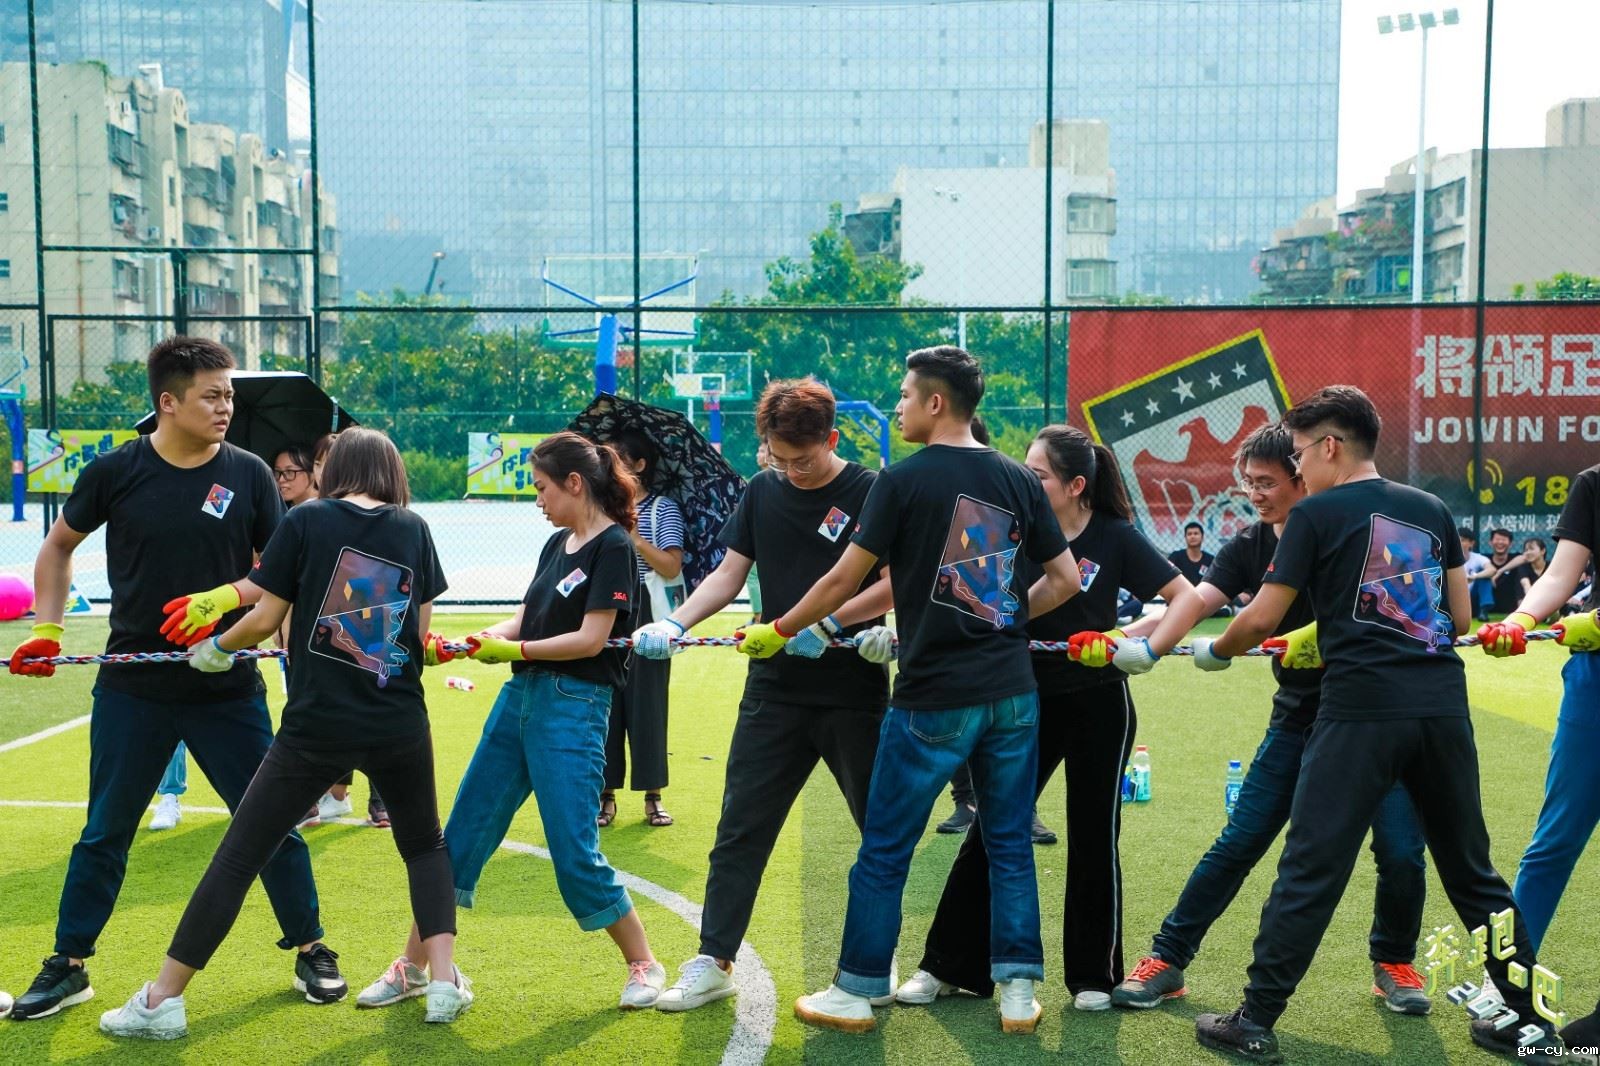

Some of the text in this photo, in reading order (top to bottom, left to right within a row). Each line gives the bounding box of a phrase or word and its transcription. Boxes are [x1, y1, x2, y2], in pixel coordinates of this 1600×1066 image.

[1414, 415, 1600, 443] JOWIN FO
[1516, 475, 1569, 506] 18
